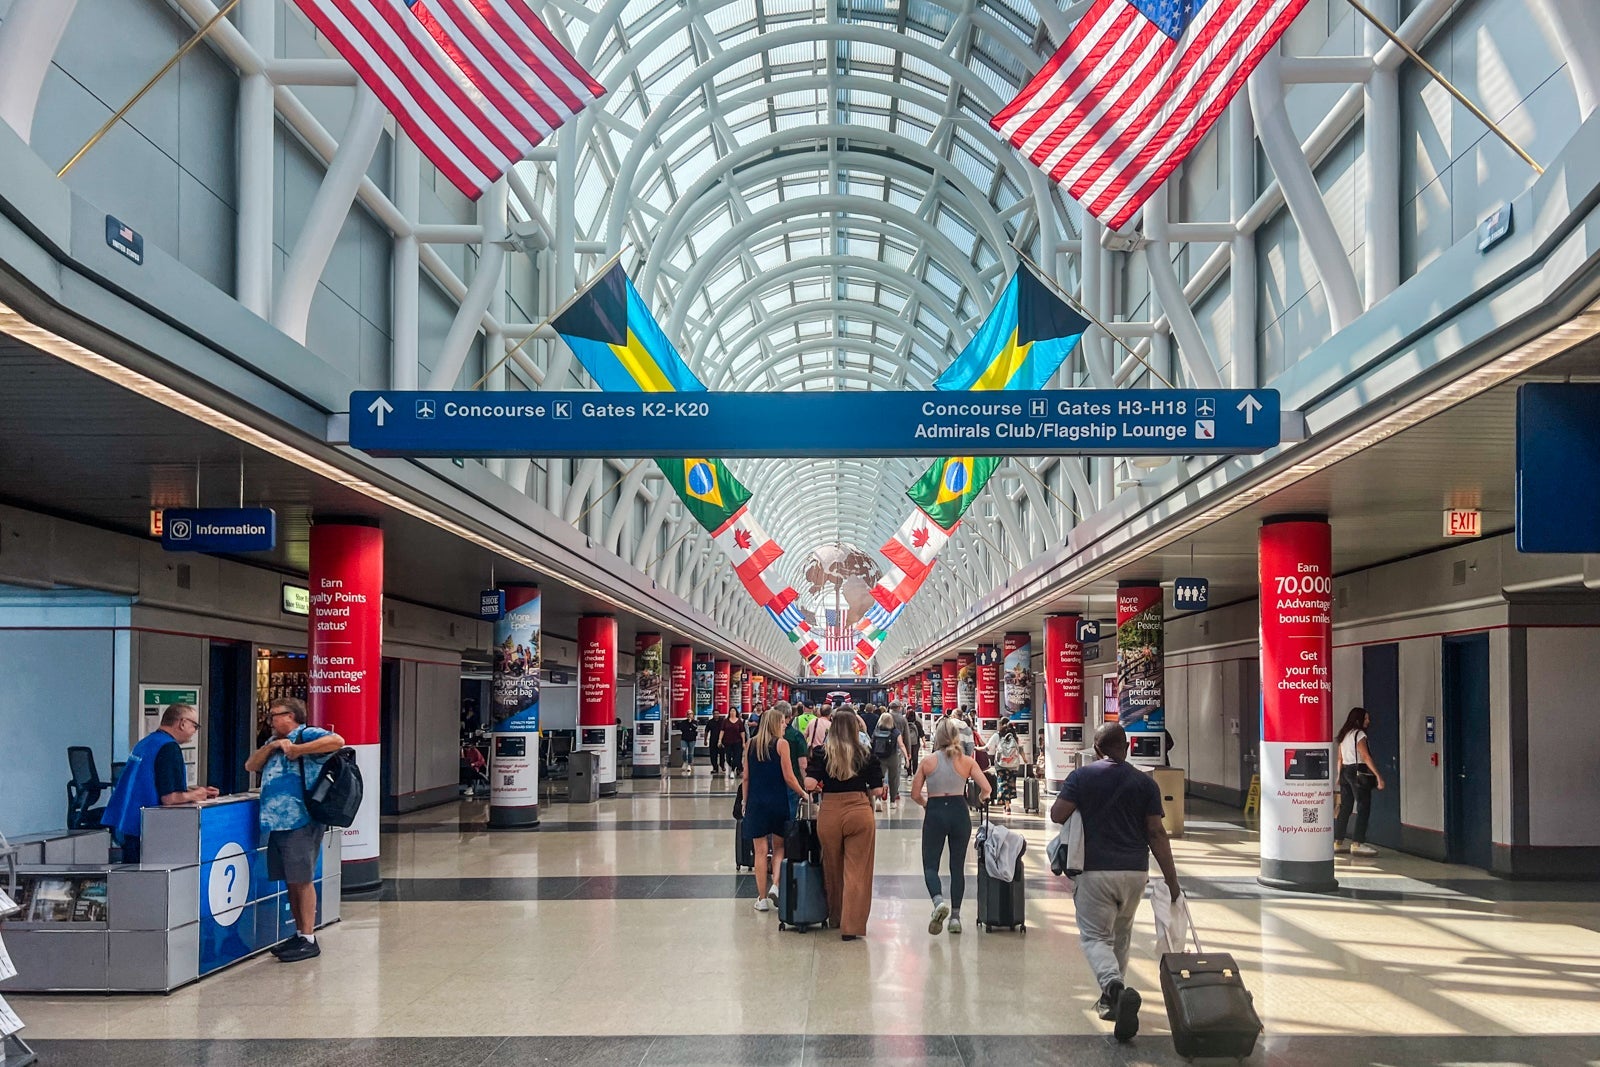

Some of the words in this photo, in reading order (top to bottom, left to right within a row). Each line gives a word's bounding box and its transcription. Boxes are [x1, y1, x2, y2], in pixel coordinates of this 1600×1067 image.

[444, 403, 545, 417] Concourse
[556, 403, 568, 417] K
[582, 403, 635, 417] Gates
[642, 403, 710, 417] K2-K20
[922, 402, 1022, 416] Concourse
[1031, 401, 1044, 415] H
[1057, 401, 1111, 415] Gates
[1118, 401, 1187, 415] H3-H18
[914, 423, 990, 438] Admirals
[996, 423, 1118, 442] Club/Flagship
[1122, 423, 1187, 442] Lounge
[1451, 512, 1477, 530] EXIT
[196, 524, 265, 535] Information
[1298, 563, 1319, 572] Earn
[321, 578, 342, 588] Earn
[1275, 576, 1331, 596] 70,000
[335, 592, 366, 603] Points
[316, 606, 350, 616] toward
[1280, 614, 1310, 623] bonus
[1312, 614, 1330, 624] miles
[313, 655, 328, 665] Plus
[330, 656, 354, 664] earn
[1300, 651, 1317, 660] Get
[1286, 667, 1310, 678] your
[1312, 665, 1327, 675] first
[502, 680, 518, 688] your
[520, 678, 534, 686] first
[1135, 678, 1155, 687] Enjoy
[1278, 680, 1318, 689] checked
[334, 683, 360, 693] miles
[520, 688, 533, 697] bag
[1128, 688, 1160, 698] preferred
[503, 697, 518, 705] free
[1130, 697, 1160, 707] boarding
[1299, 694, 1319, 704] free
